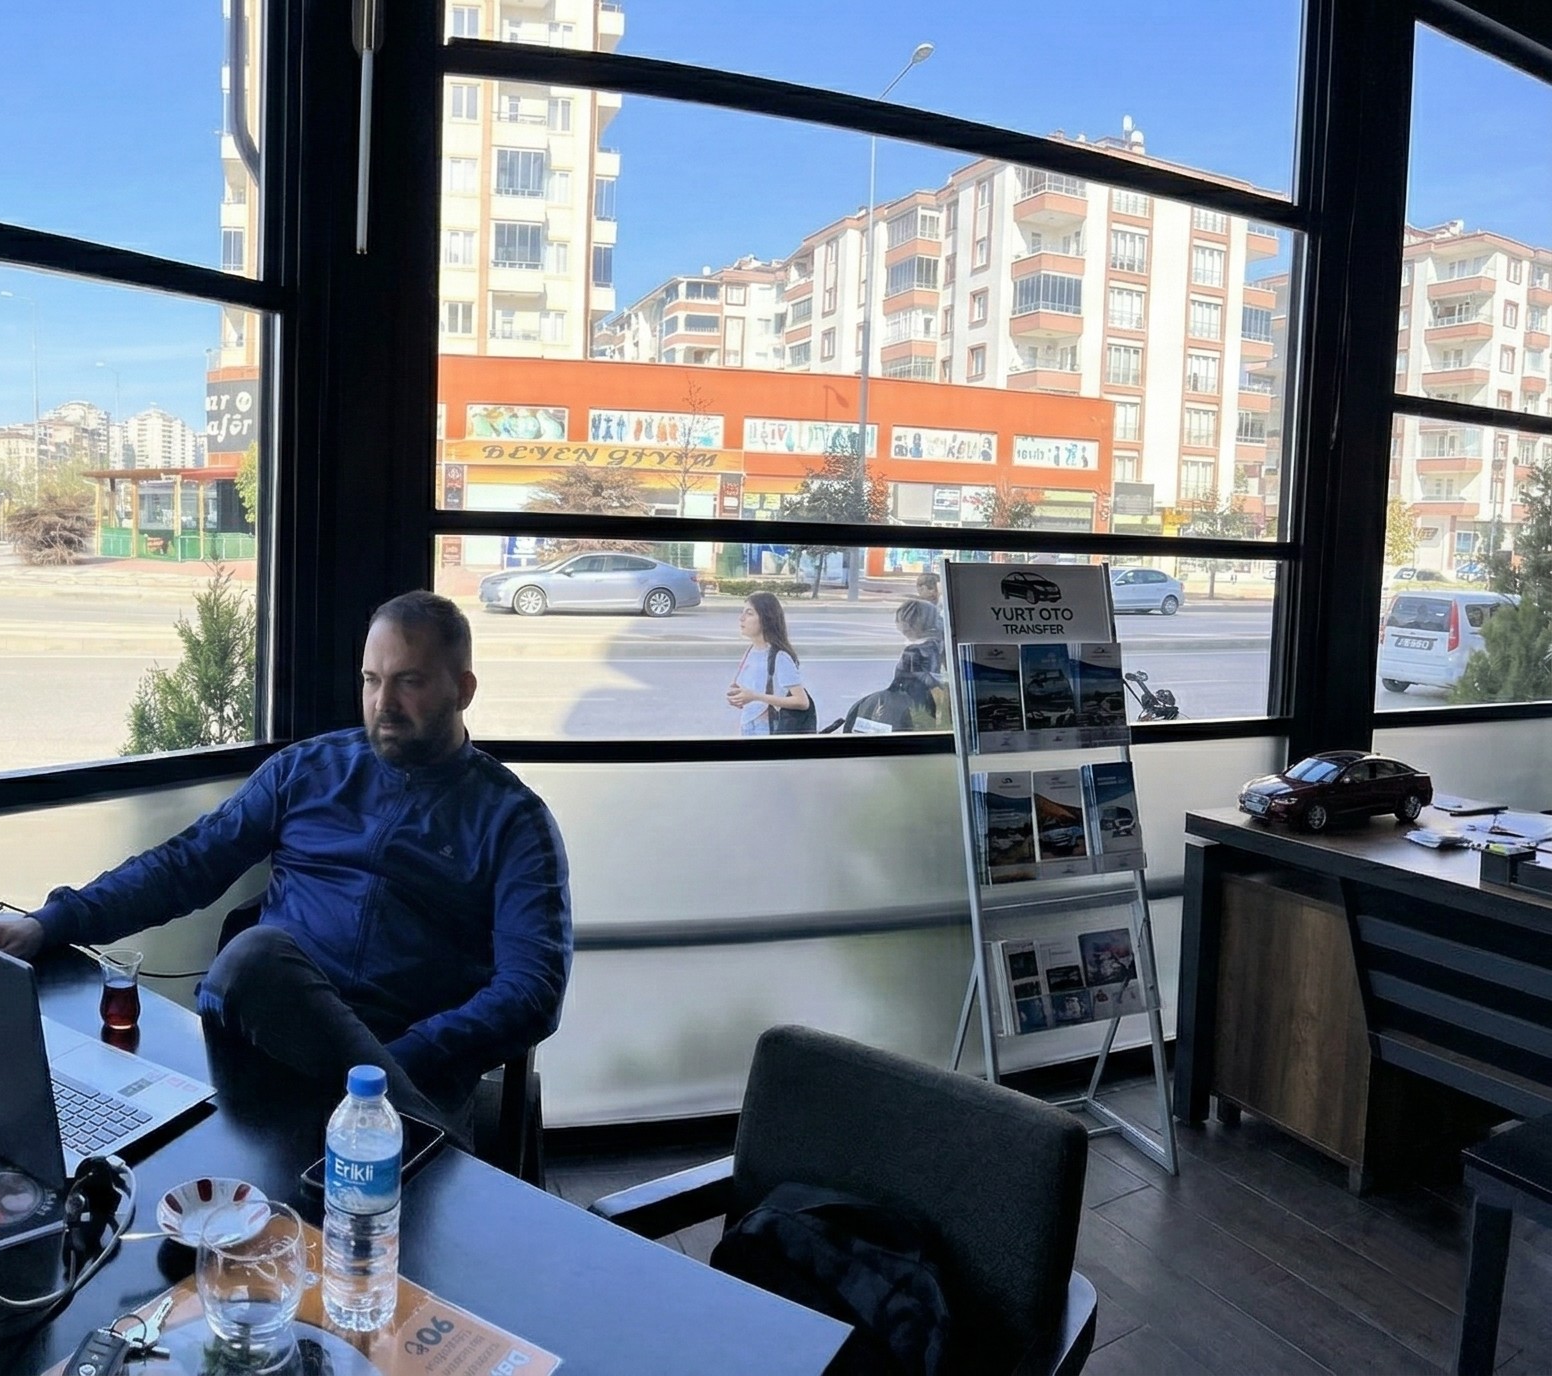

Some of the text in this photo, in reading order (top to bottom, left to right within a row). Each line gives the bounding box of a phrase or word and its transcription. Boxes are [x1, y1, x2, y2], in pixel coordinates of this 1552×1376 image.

[991, 607, 1073, 621] YURT OTO
[1002, 624, 1064, 635] TRANSFER
